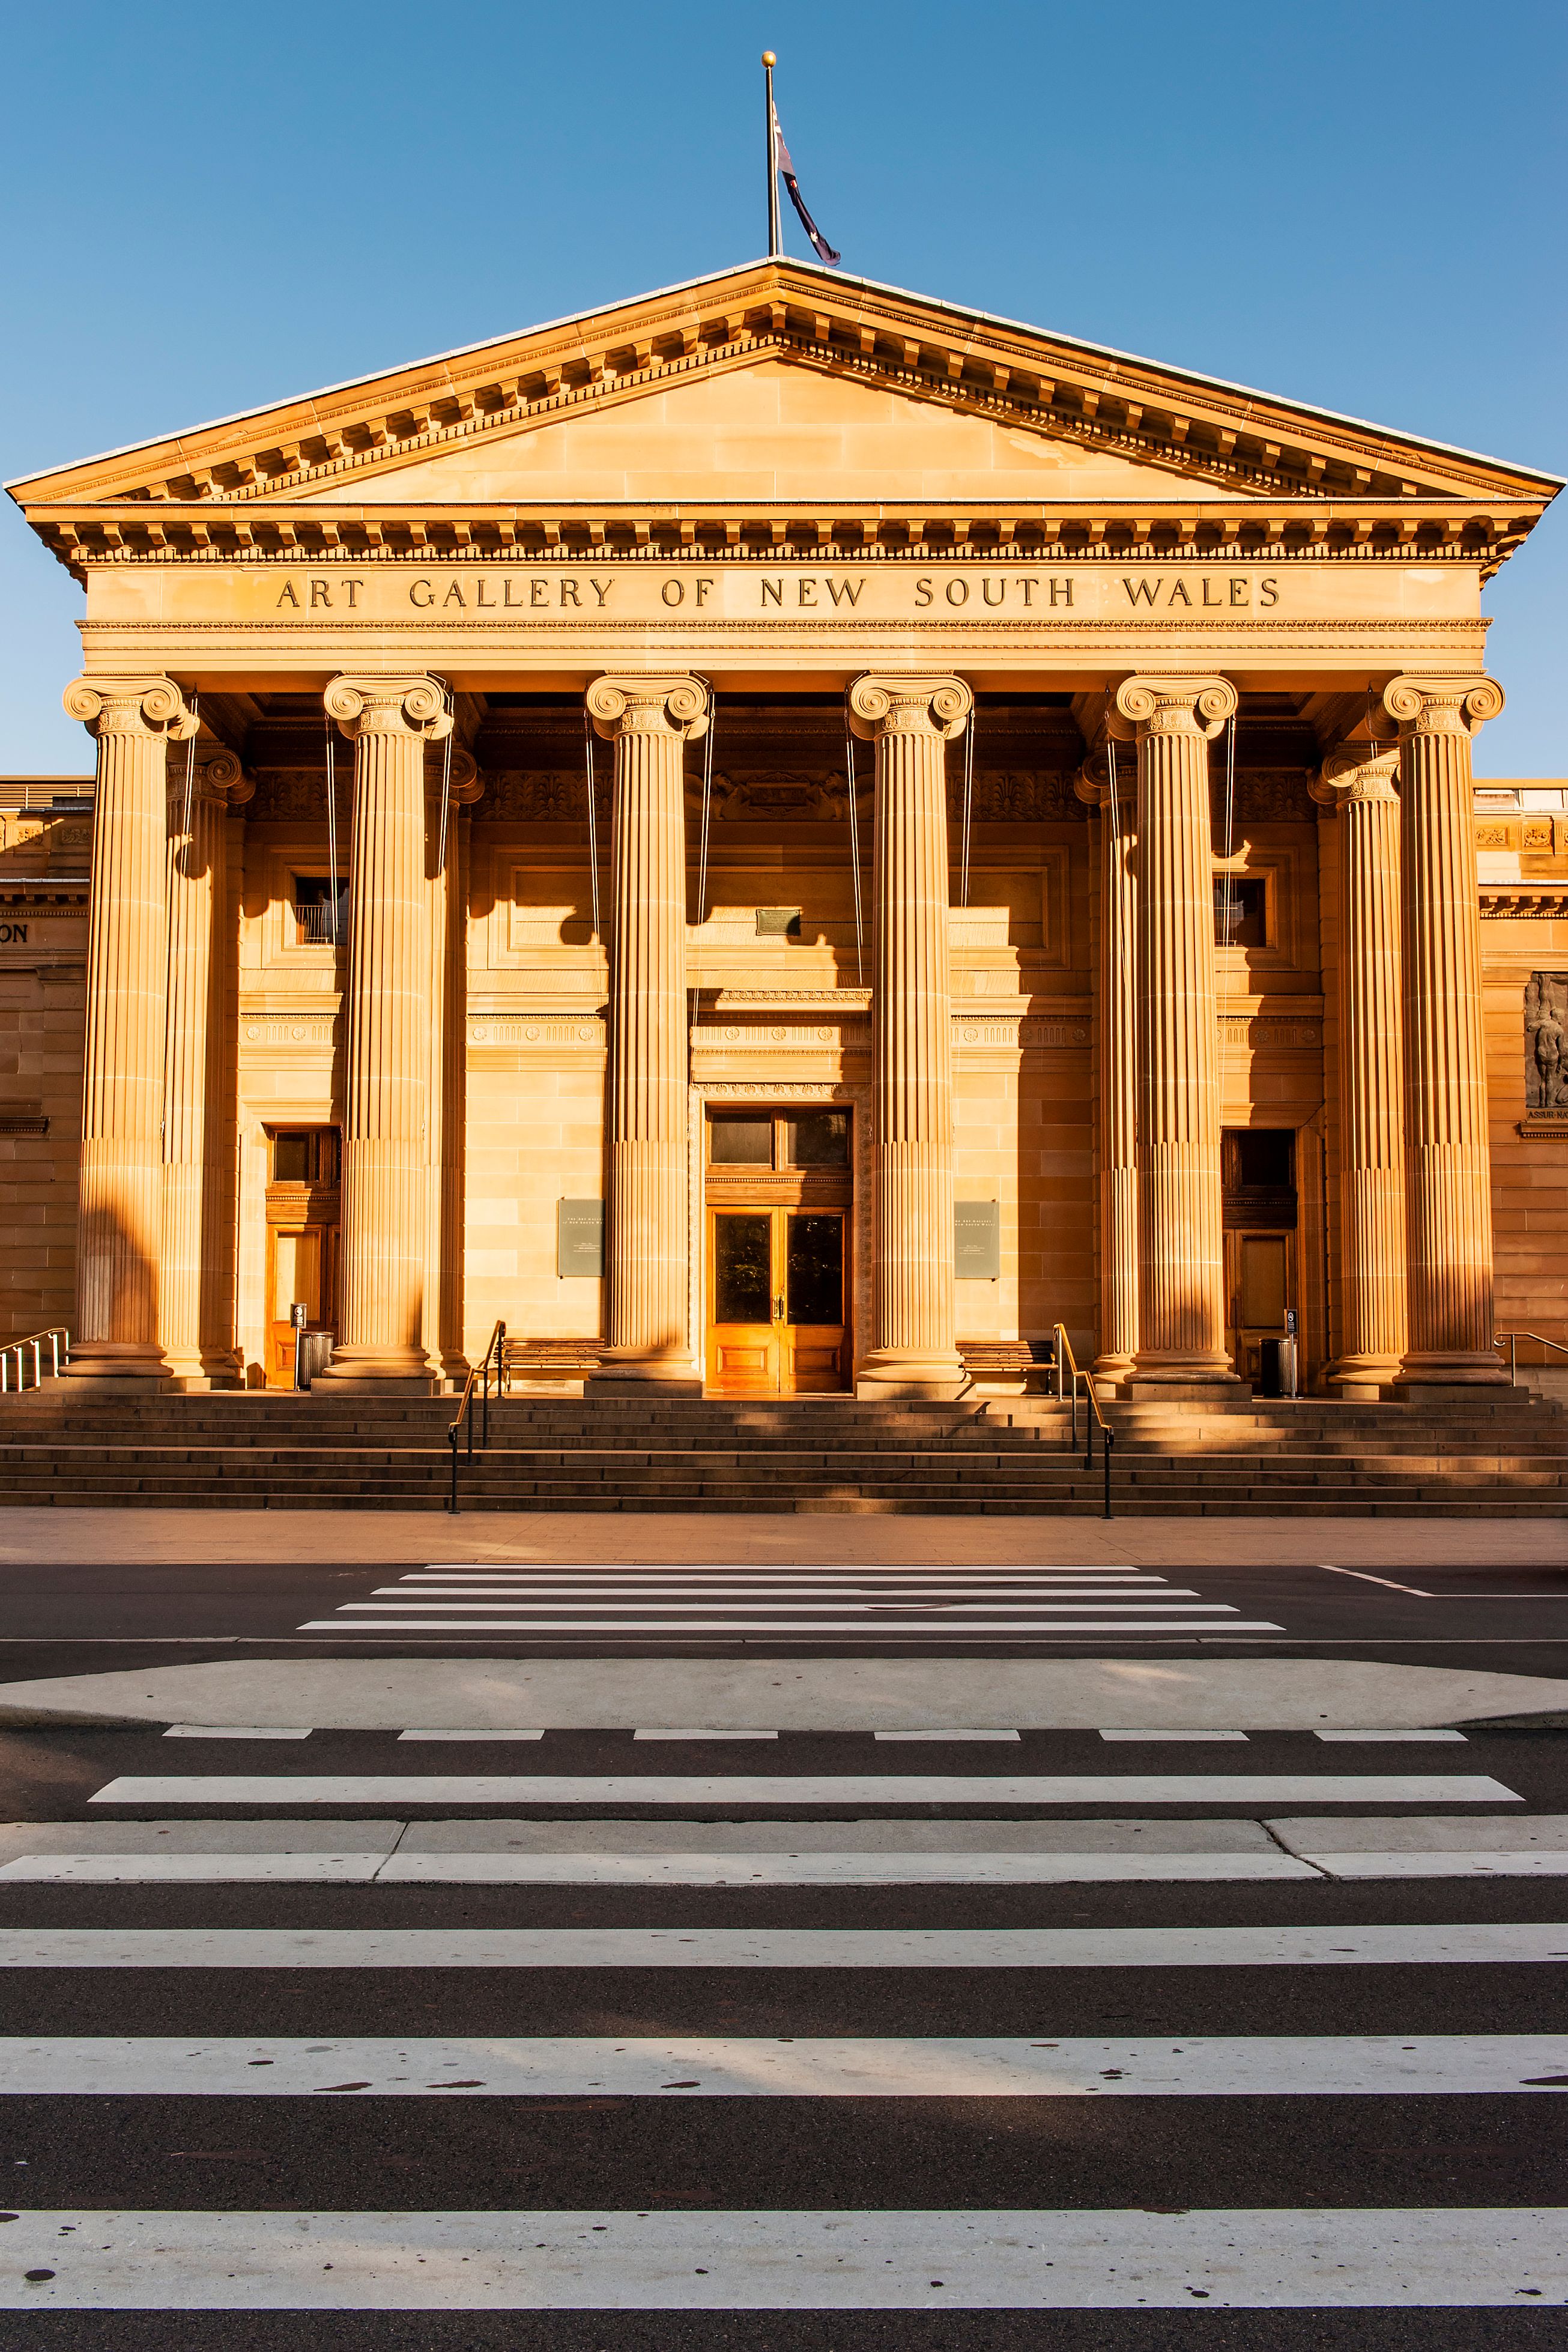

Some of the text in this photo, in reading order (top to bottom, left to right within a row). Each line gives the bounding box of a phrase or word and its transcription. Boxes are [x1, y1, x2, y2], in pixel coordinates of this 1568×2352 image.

[276, 578, 1280, 608] ART GALLERY OF NEW SOUTH WALES
